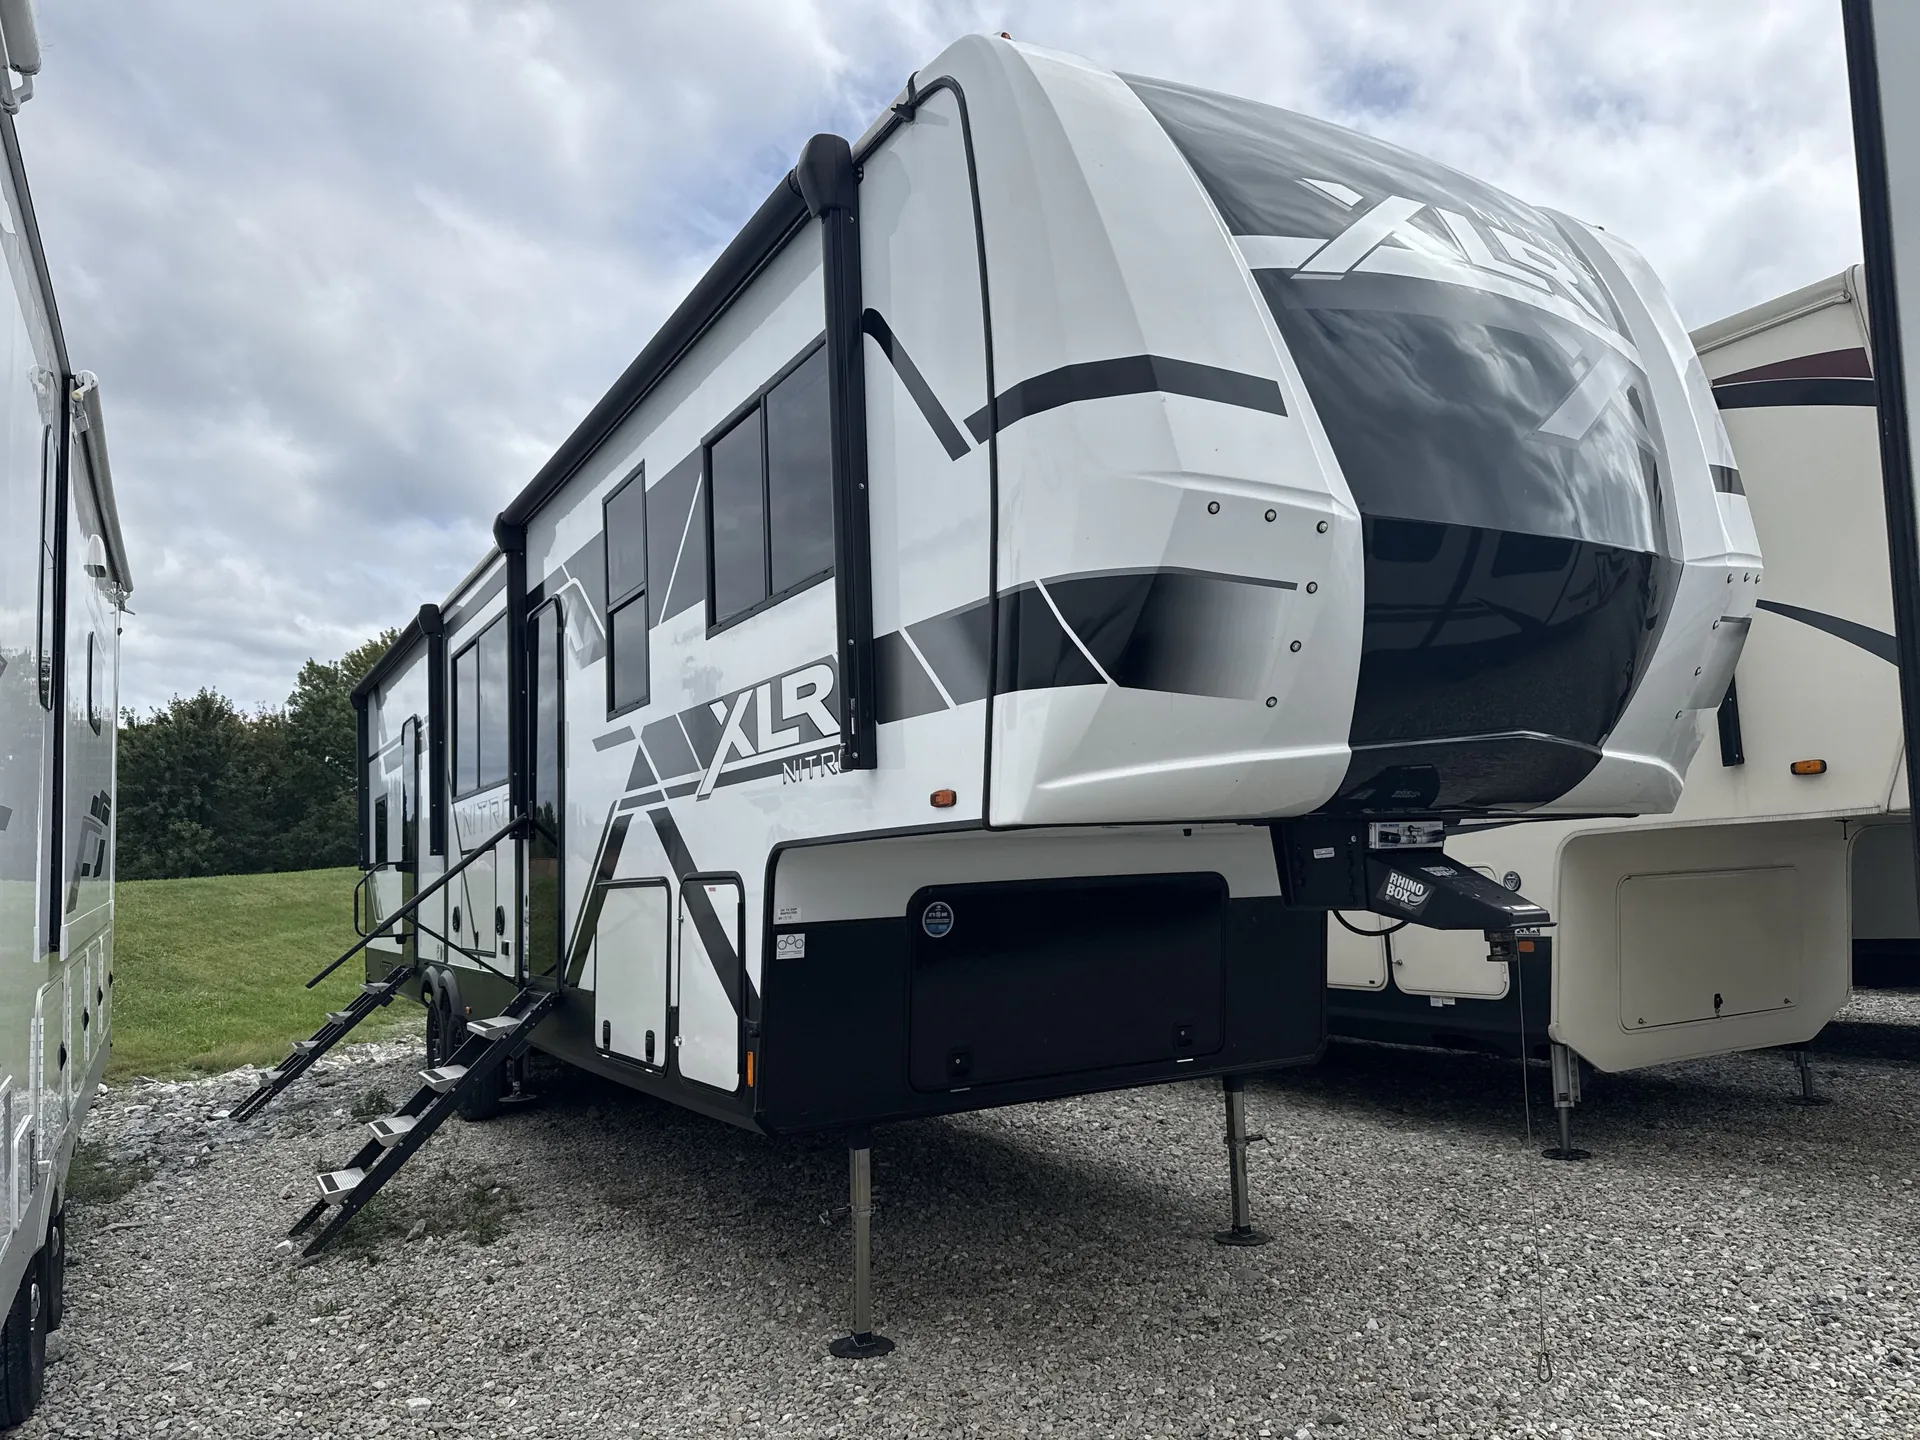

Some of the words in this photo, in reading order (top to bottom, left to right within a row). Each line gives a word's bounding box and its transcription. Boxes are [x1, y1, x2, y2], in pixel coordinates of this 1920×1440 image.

[1293, 177, 1609, 328] XLR
[697, 663, 841, 801] XLR
[1386, 883, 1411, 903] BOX
[1389, 872, 1424, 895] RHINO
